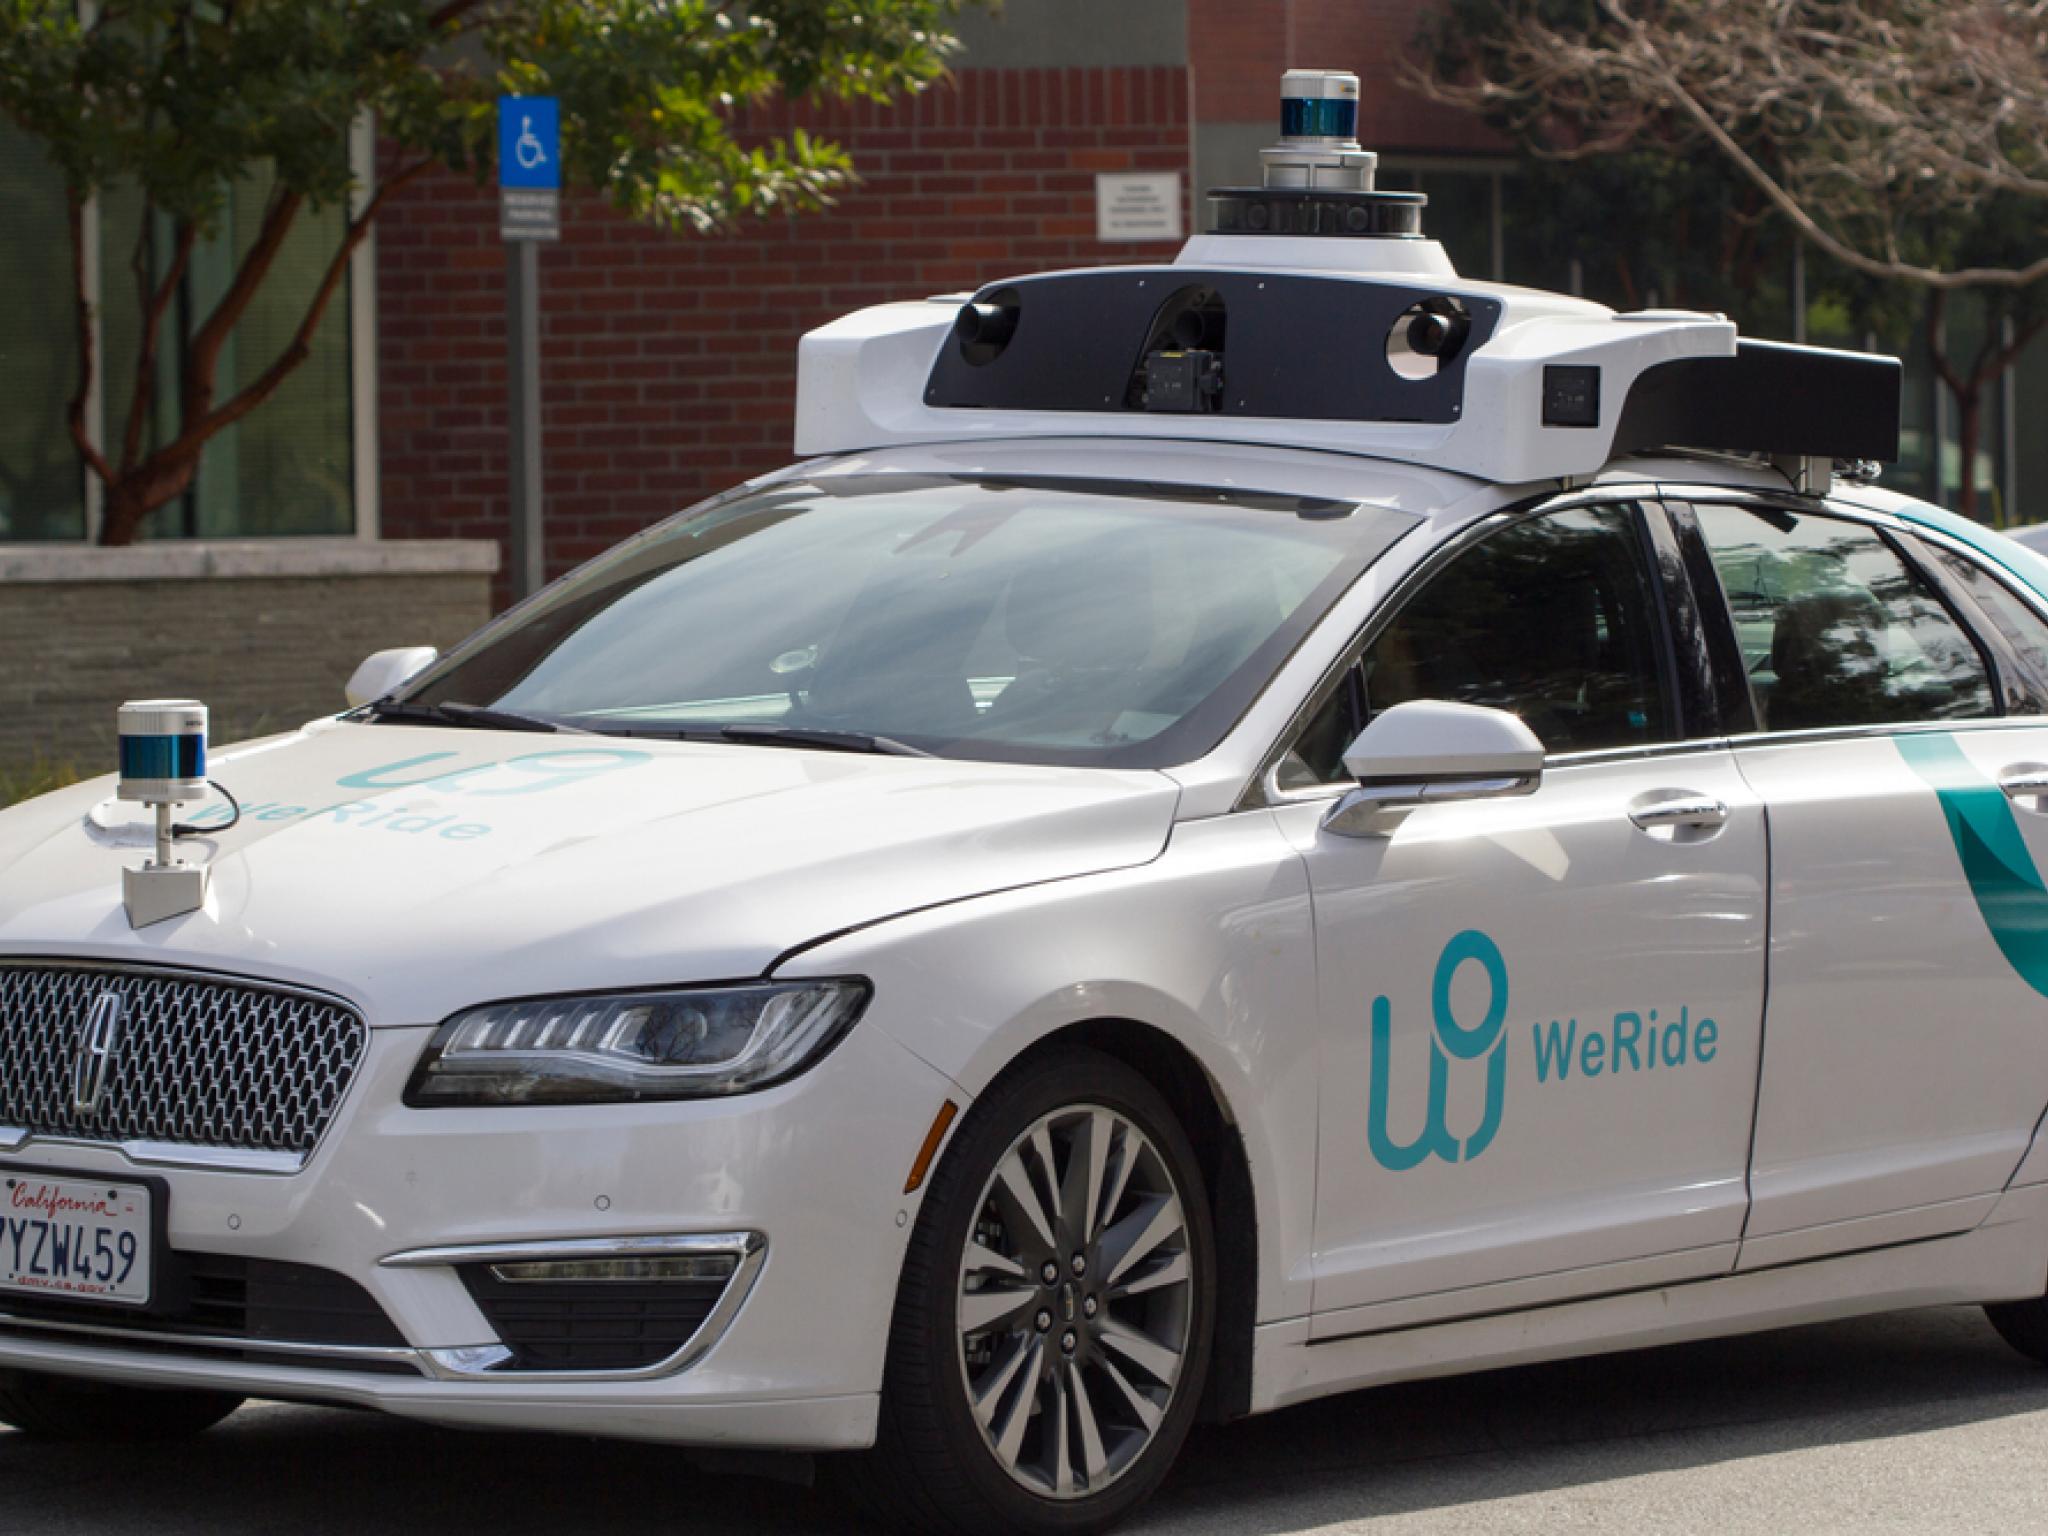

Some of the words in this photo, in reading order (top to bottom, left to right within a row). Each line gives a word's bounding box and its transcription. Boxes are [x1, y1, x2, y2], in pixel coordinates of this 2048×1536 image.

[1533, 1006, 1718, 1083] WeRide
[12, 1181, 117, 1218] California
[18, 1275, 106, 1293] dmv.ca.gov
